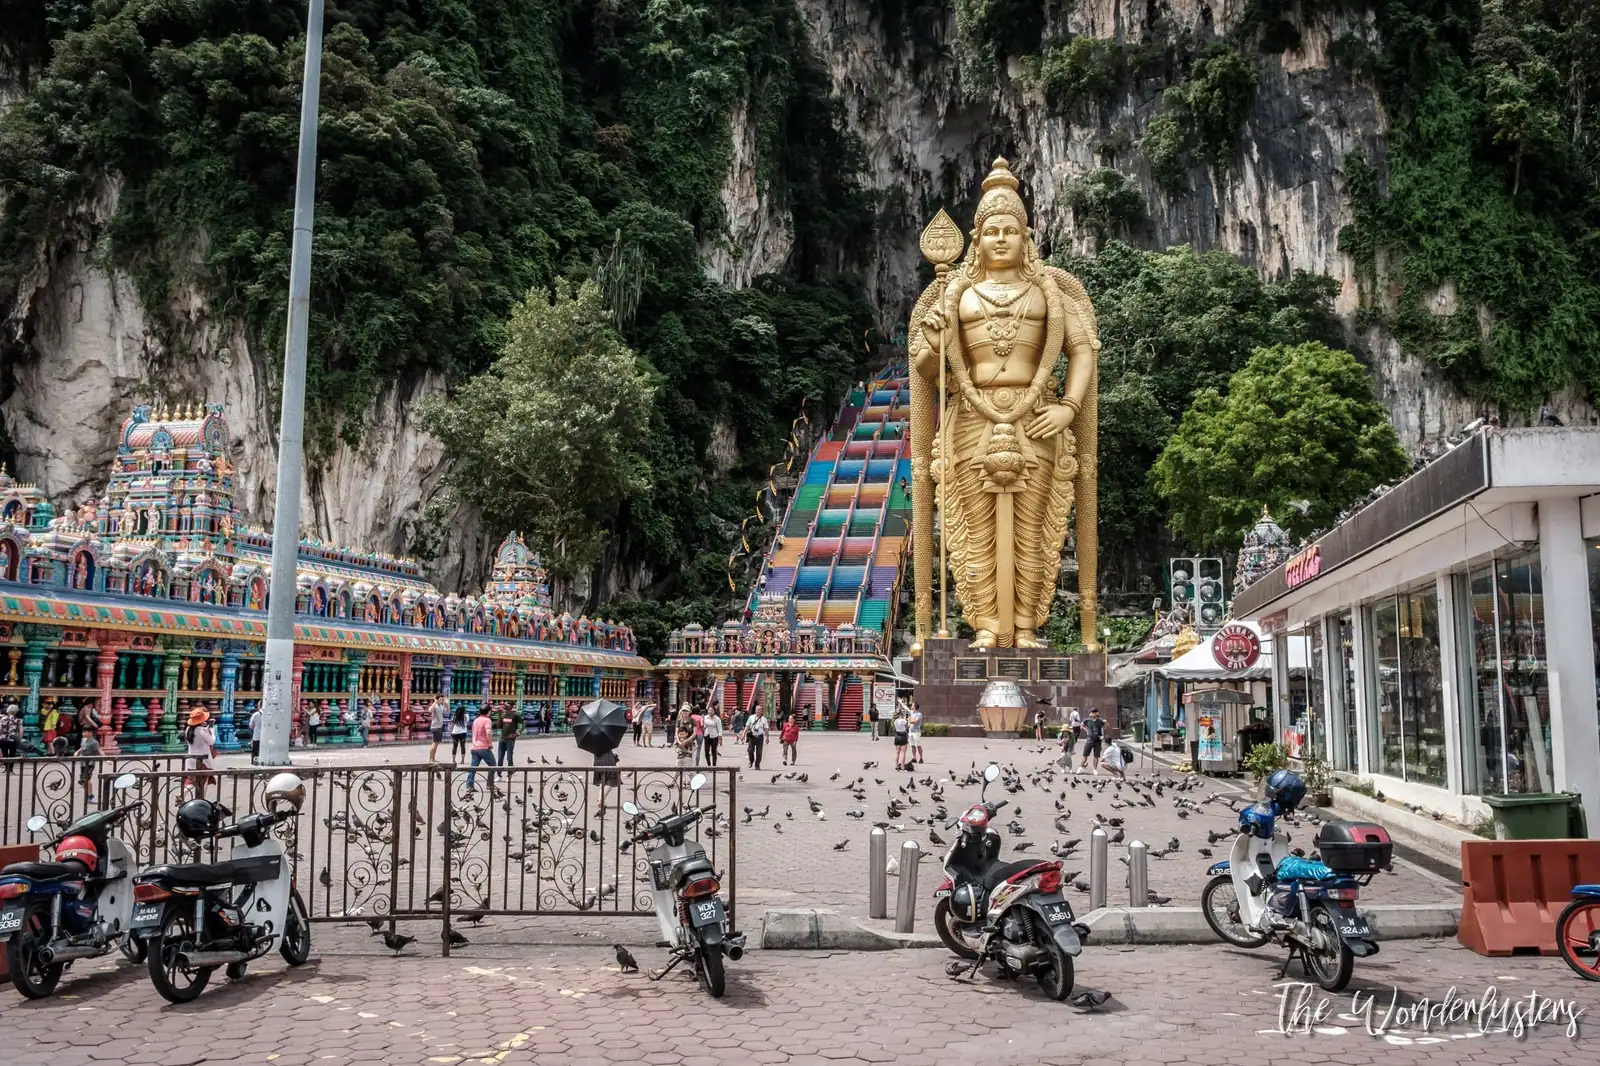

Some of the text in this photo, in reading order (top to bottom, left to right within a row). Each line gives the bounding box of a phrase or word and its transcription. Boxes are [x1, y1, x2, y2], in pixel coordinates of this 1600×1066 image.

[1227, 660, 1248, 669] CAFE
[697, 901, 715, 912] WDK
[1053, 905, 1060, 913] W
[134, 913, 159, 922] 4202
[700, 909, 716, 921] 327
[1048, 911, 1071, 921] 396U
[1347, 917, 1355, 926] W
